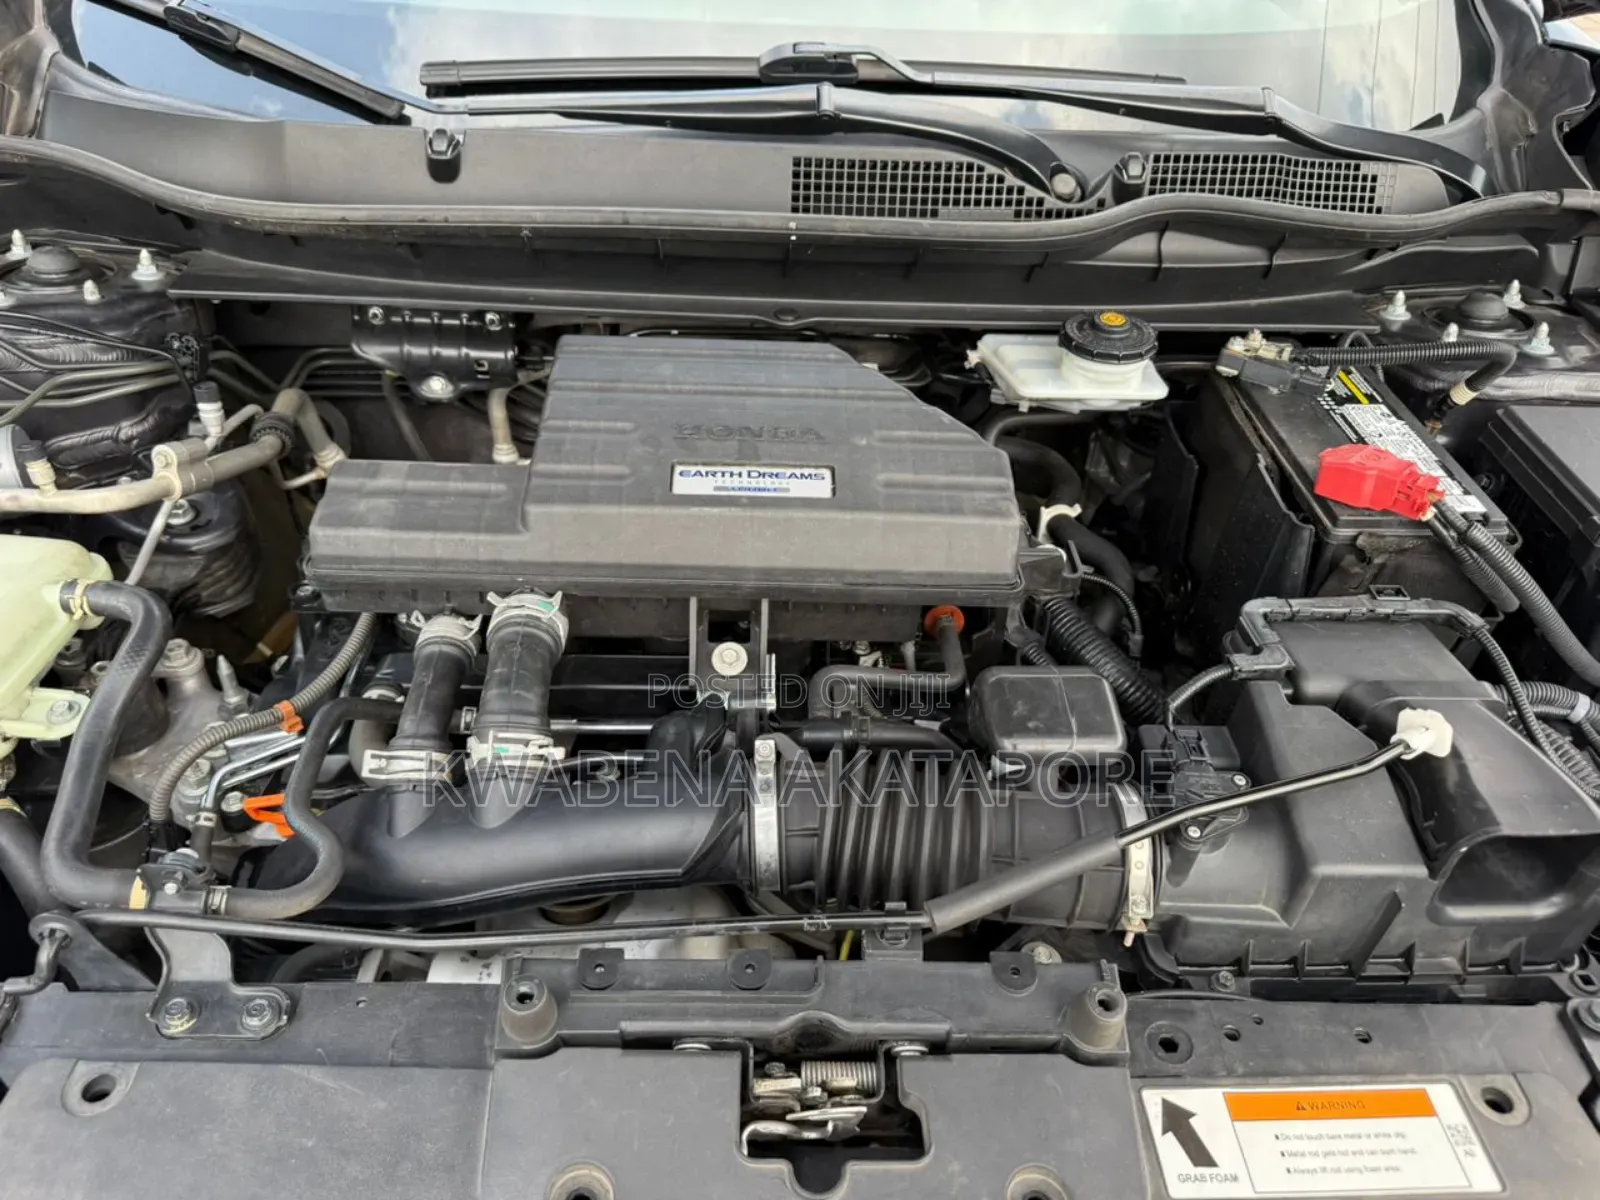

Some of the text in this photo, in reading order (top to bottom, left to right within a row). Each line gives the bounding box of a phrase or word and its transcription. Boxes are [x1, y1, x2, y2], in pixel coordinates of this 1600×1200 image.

[673, 423, 828, 444] HONDA
[679, 469, 826, 481] EARTH DREAMS
[1308, 1100, 1366, 1111] WARNING
[1177, 1173, 1240, 1183] GRAB FOAM
